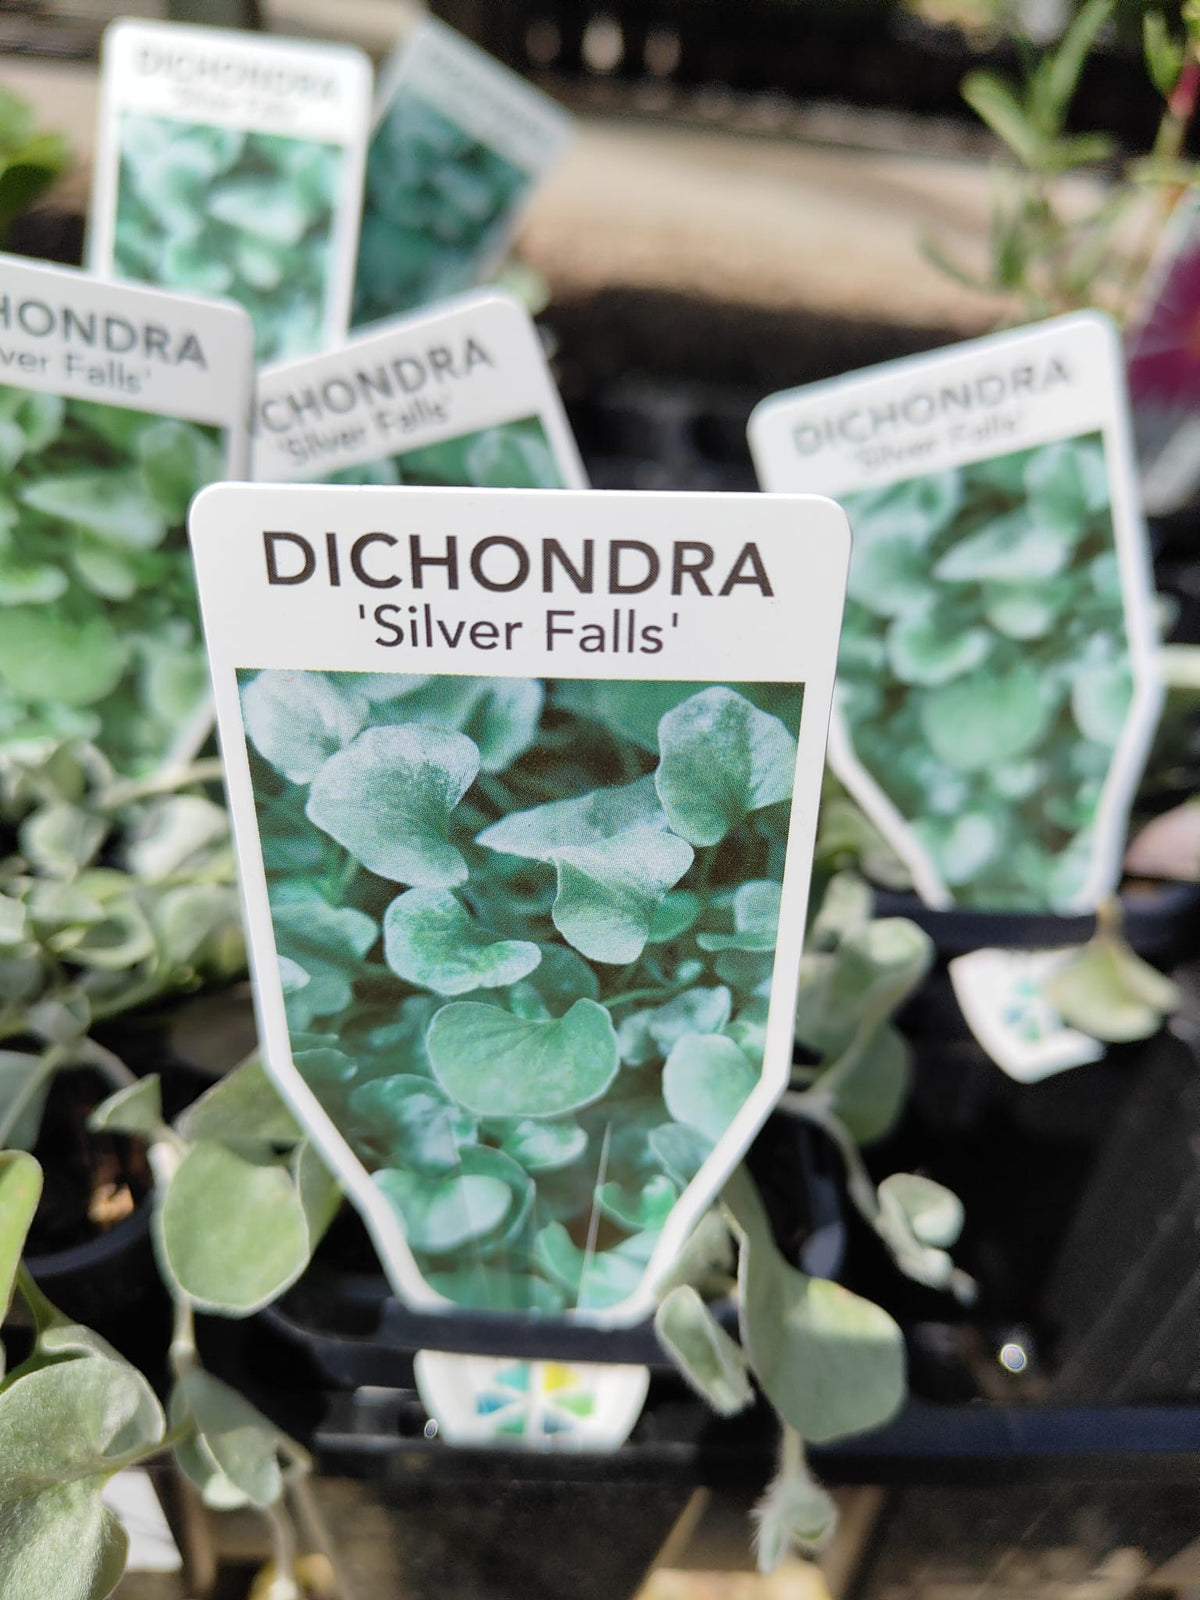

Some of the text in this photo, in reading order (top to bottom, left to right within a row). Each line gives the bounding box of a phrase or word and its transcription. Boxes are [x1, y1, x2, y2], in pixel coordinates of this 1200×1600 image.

[791, 355, 1075, 457] DICHONDRA
[262, 530, 775, 598] DICHONDRA
[358, 603, 680, 655] 'Silver Falls'
